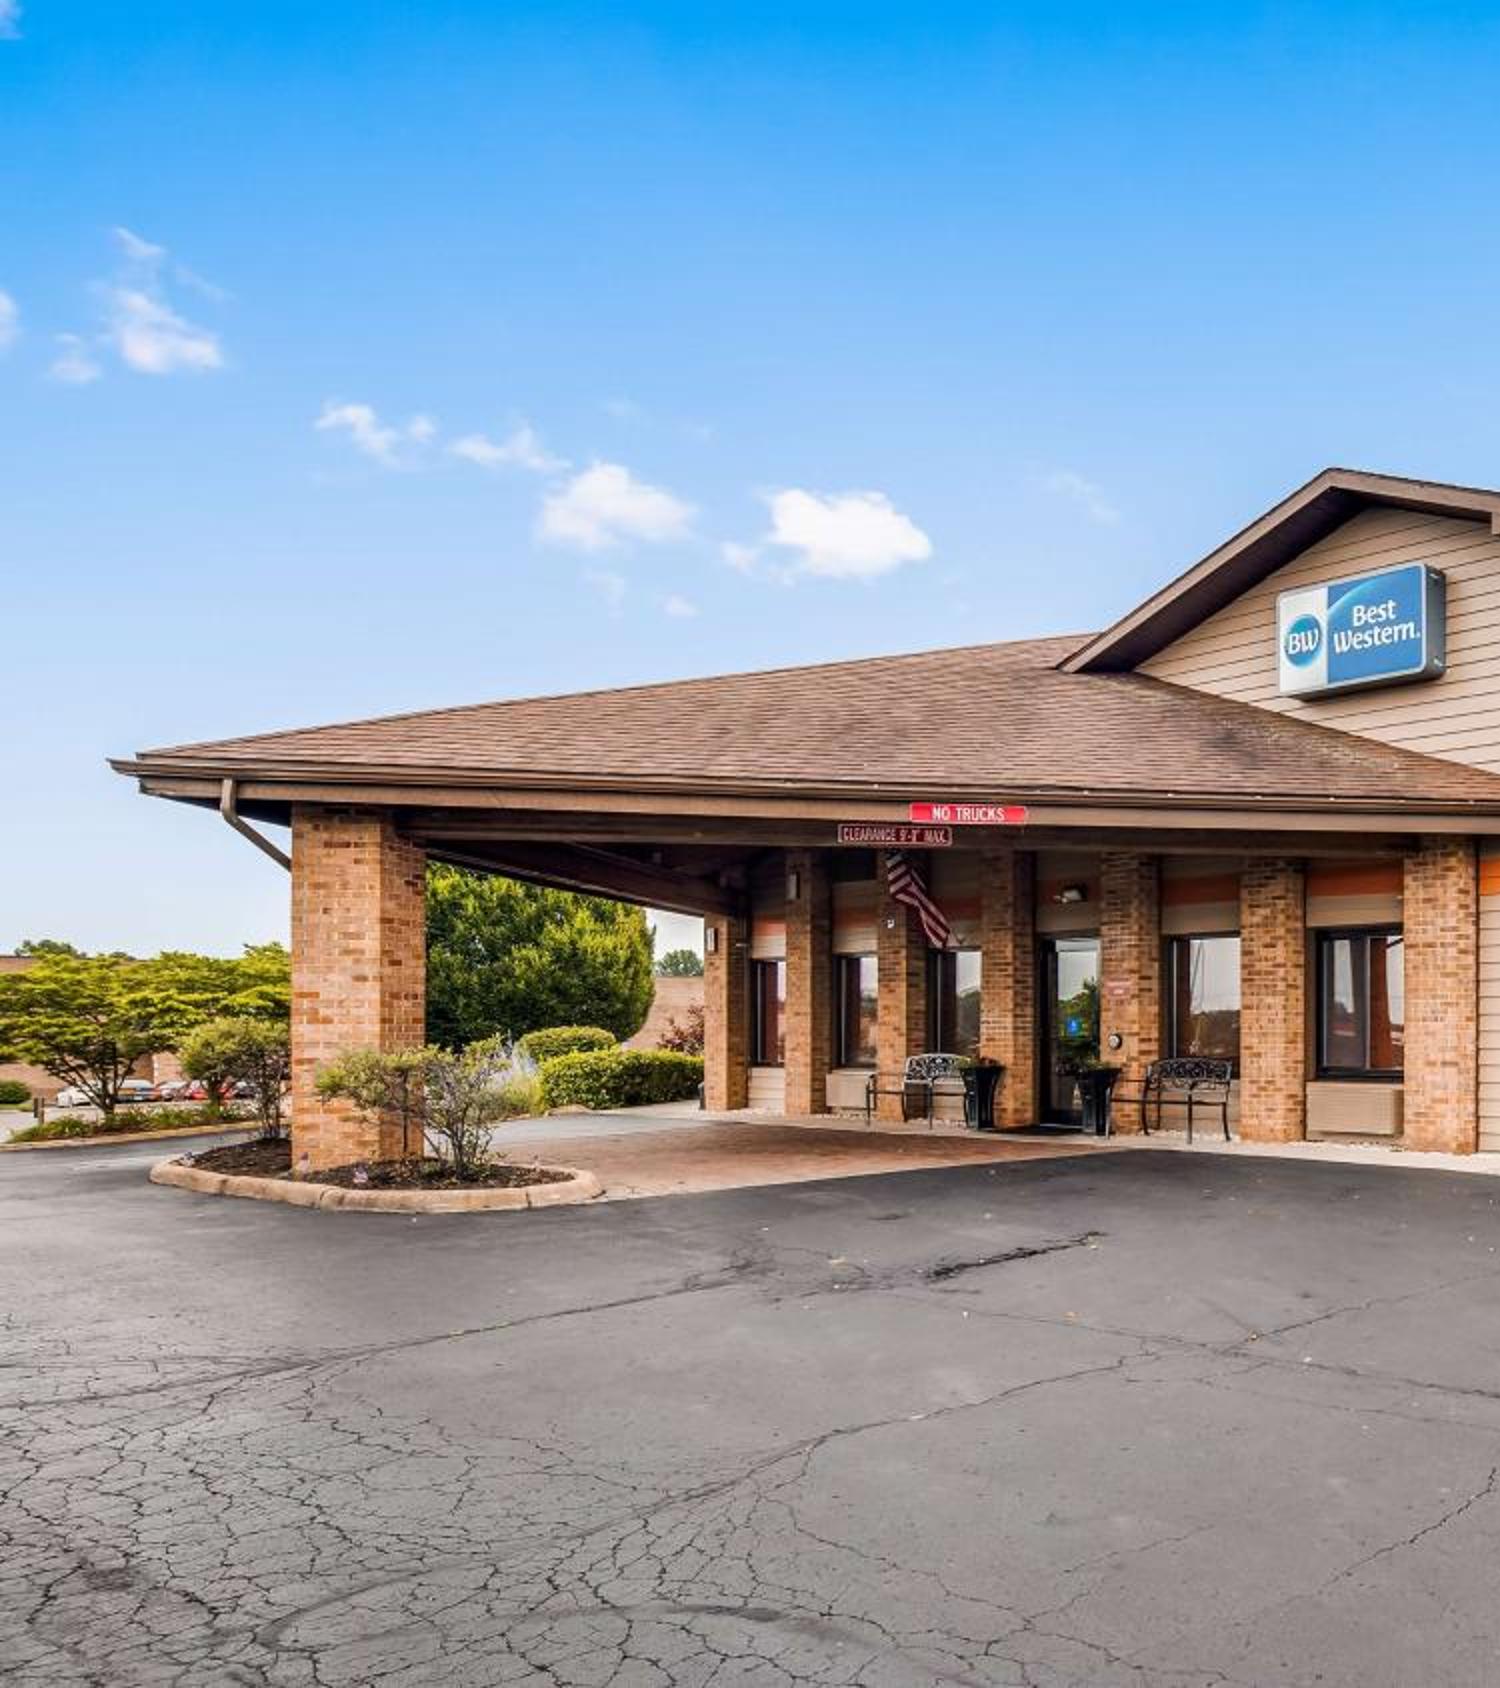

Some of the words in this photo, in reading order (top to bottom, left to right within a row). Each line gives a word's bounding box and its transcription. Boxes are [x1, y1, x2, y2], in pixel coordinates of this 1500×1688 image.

[1353, 599, 1396, 627] Best
[1288, 627, 1319, 655] BW
[932, 807, 950, 821] NO
[956, 807, 1005, 821] TRUCKS
[843, 827, 896, 841] CLEARANCE
